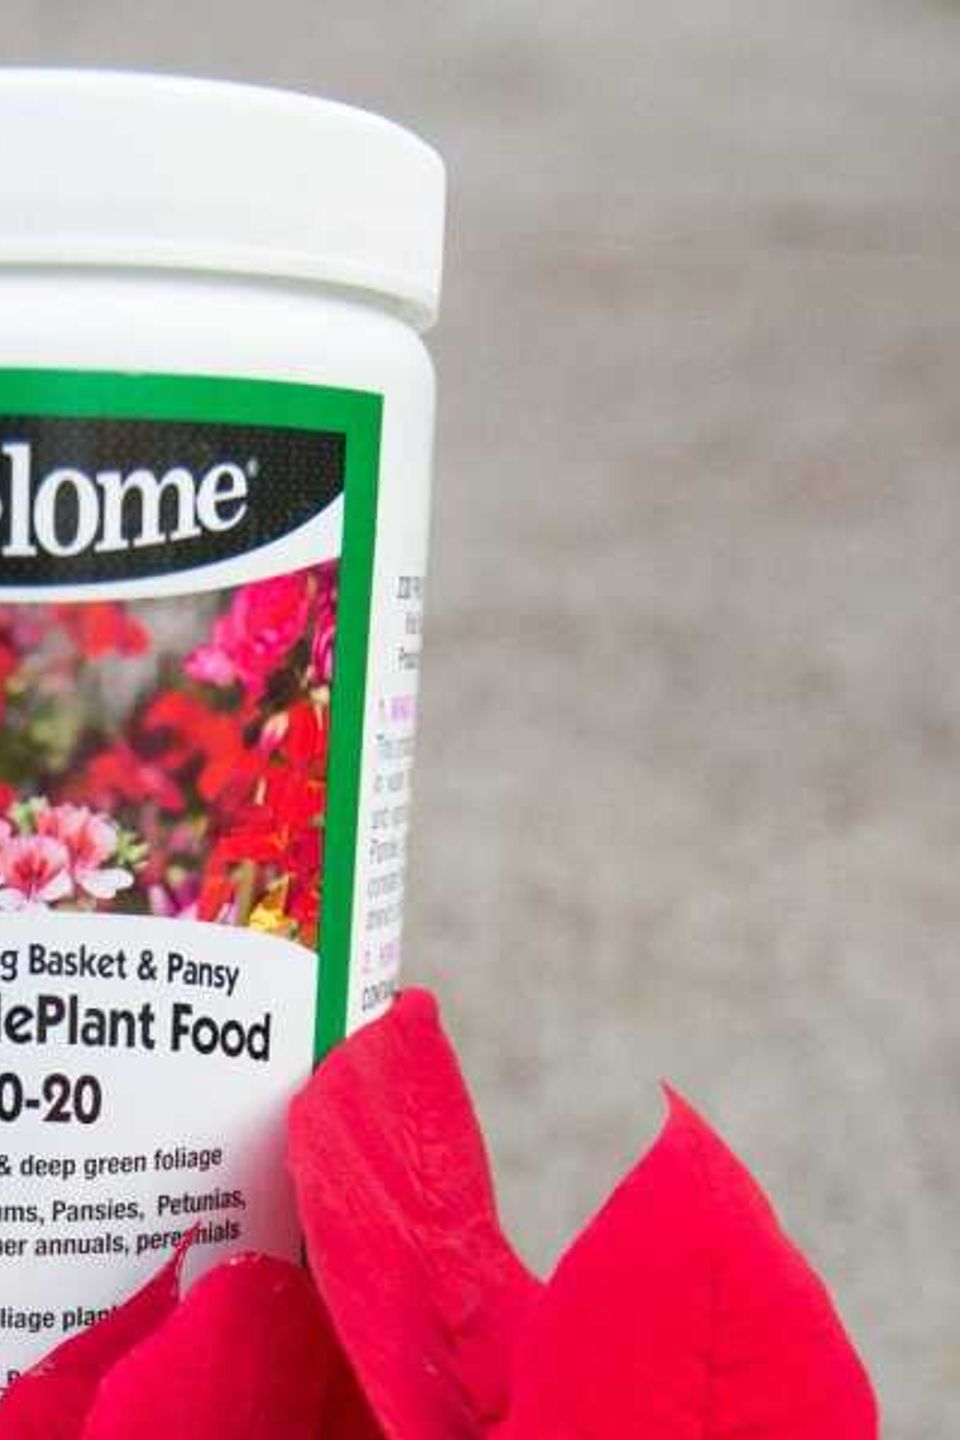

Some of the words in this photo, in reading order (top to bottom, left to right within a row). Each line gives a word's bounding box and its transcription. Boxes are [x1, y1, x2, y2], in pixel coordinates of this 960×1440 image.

[29, 943, 127, 980] Basket
[137, 950, 157, 979] &
[168, 953, 239, 996] Pansy
[171, 1003, 271, 1062] Food
[20, 1155, 76, 1179] deep
[84, 1155, 147, 1180] green
[154, 1148, 222, 1171] foliage
[52, 1199, 145, 1222] Pansies,
[158, 1188, 246, 1216] Petunias,
[35, 1232, 129, 1257] annuals,
[137, 1219, 240, 1257] perenials
[62, 1306, 116, 1332] plan
